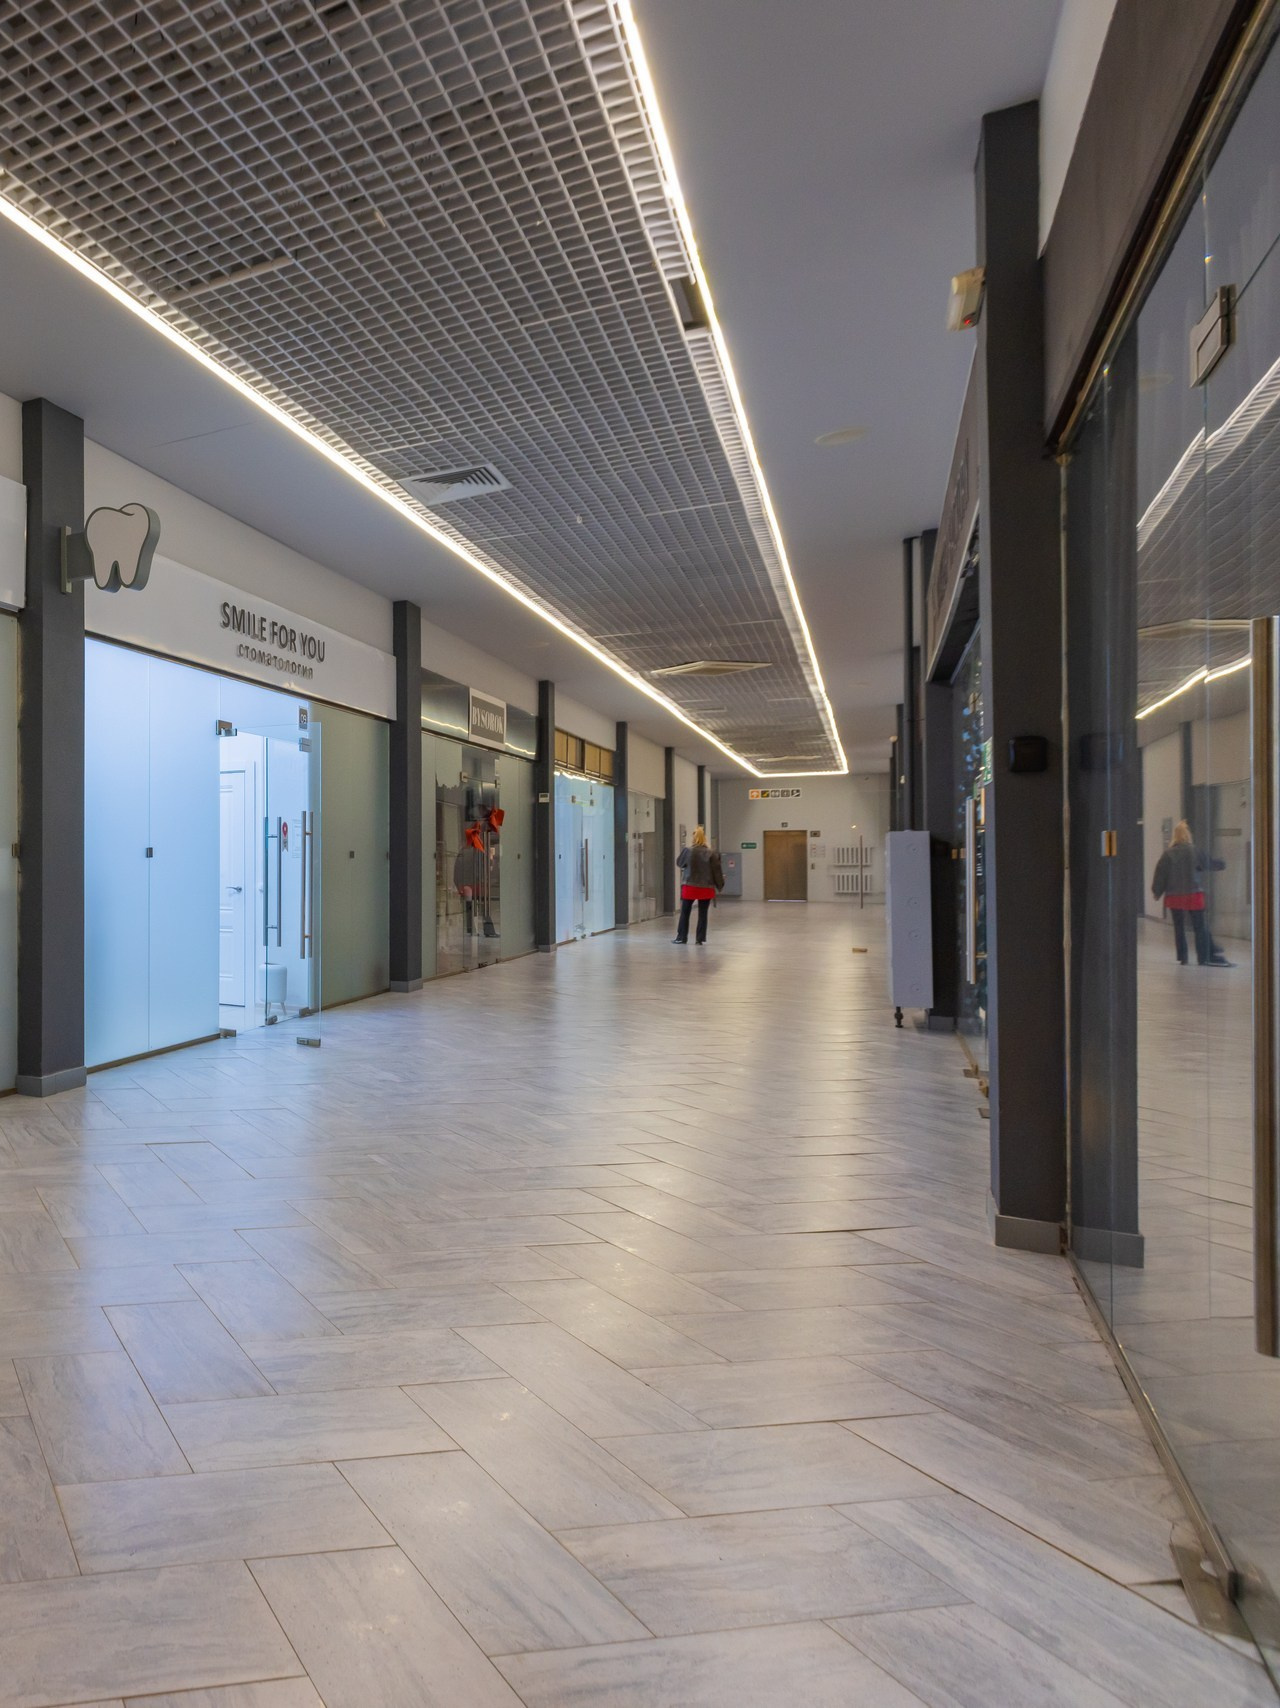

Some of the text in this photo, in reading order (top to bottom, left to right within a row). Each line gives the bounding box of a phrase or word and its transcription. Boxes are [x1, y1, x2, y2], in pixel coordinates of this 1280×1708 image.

[221, 602, 325, 663] SMILE FOR YOU
[472, 706, 504, 734] BYSOROK
